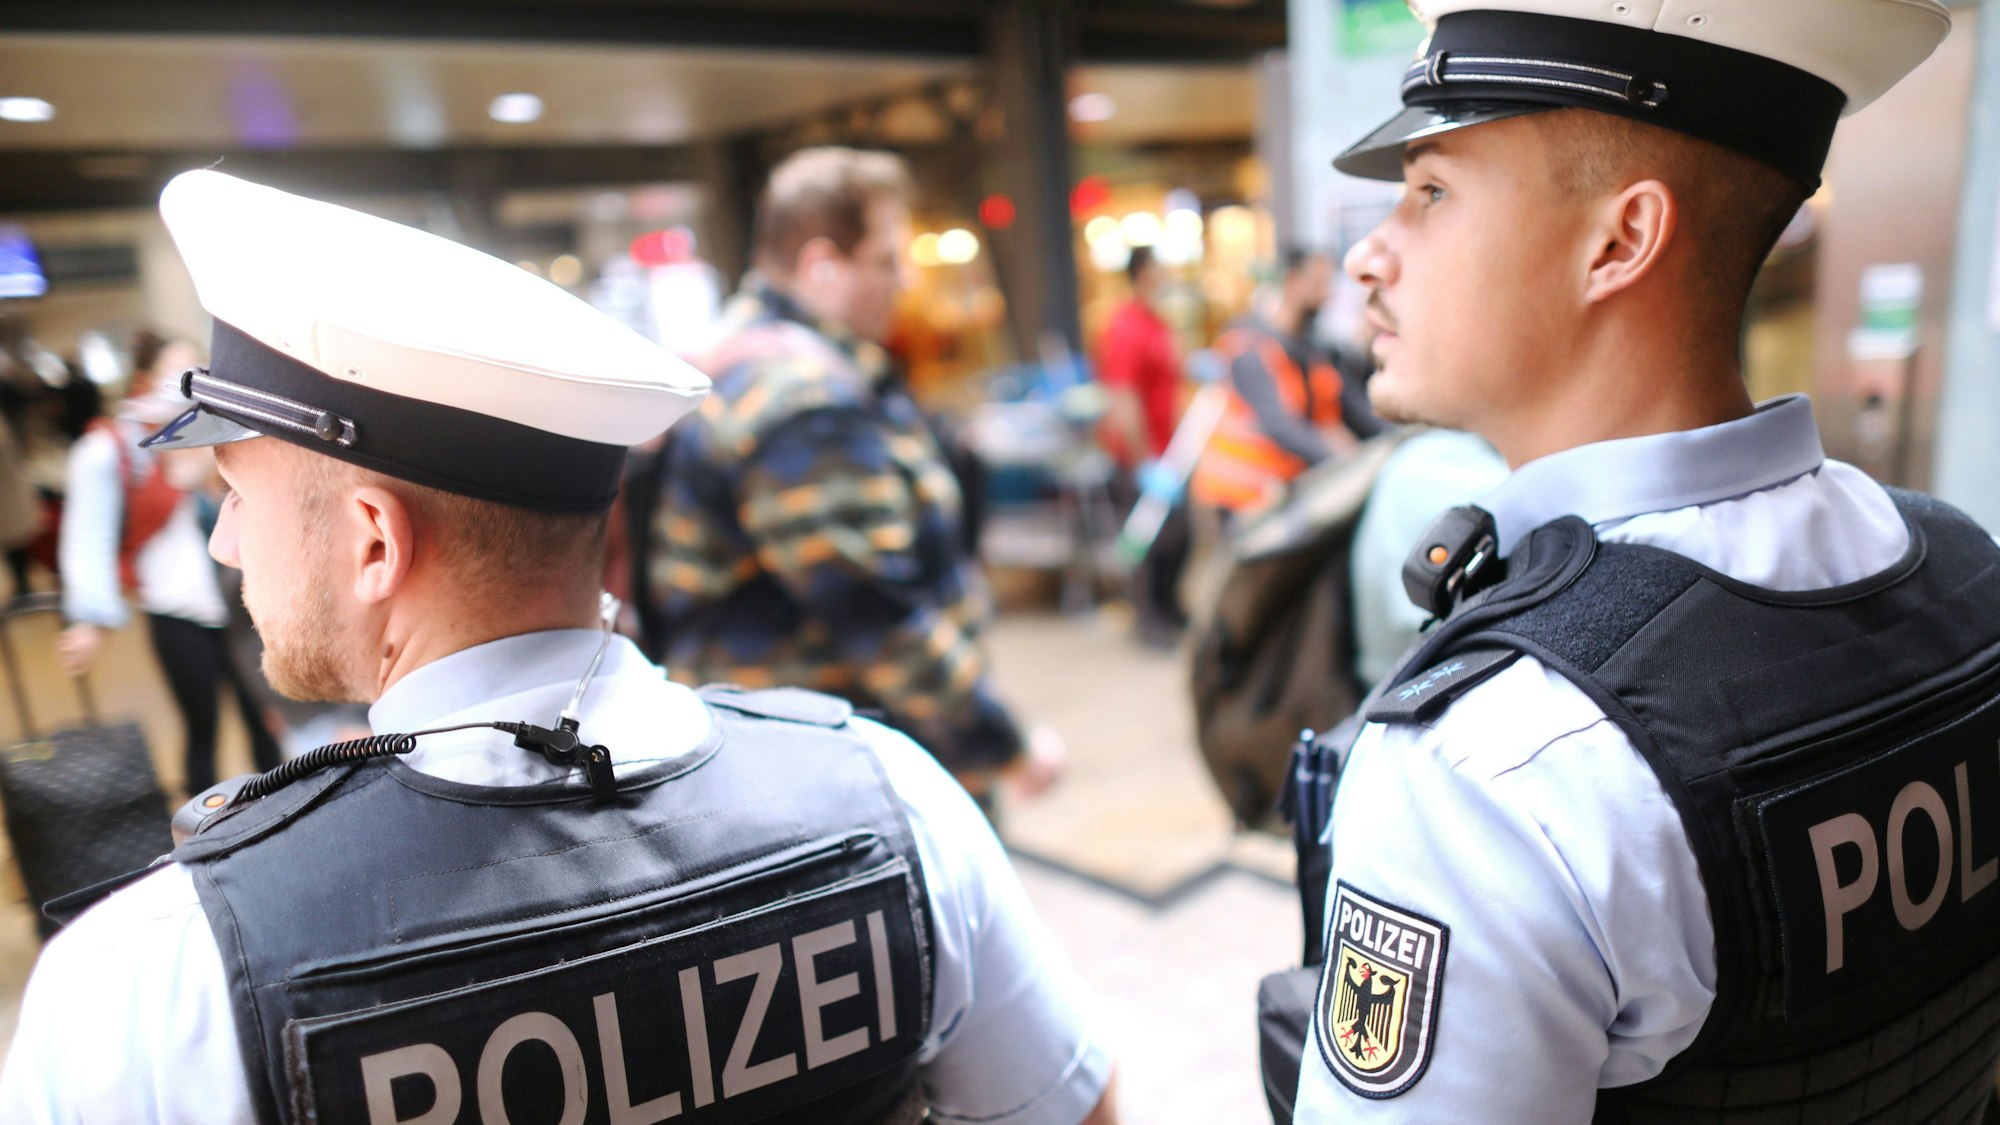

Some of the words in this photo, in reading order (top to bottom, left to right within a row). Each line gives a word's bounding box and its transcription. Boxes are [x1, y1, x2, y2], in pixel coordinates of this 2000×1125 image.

[1339, 901, 1427, 970] POLIZEI
[1808, 739, 2000, 974] POL
[361, 910, 897, 1125] POLIZEI
